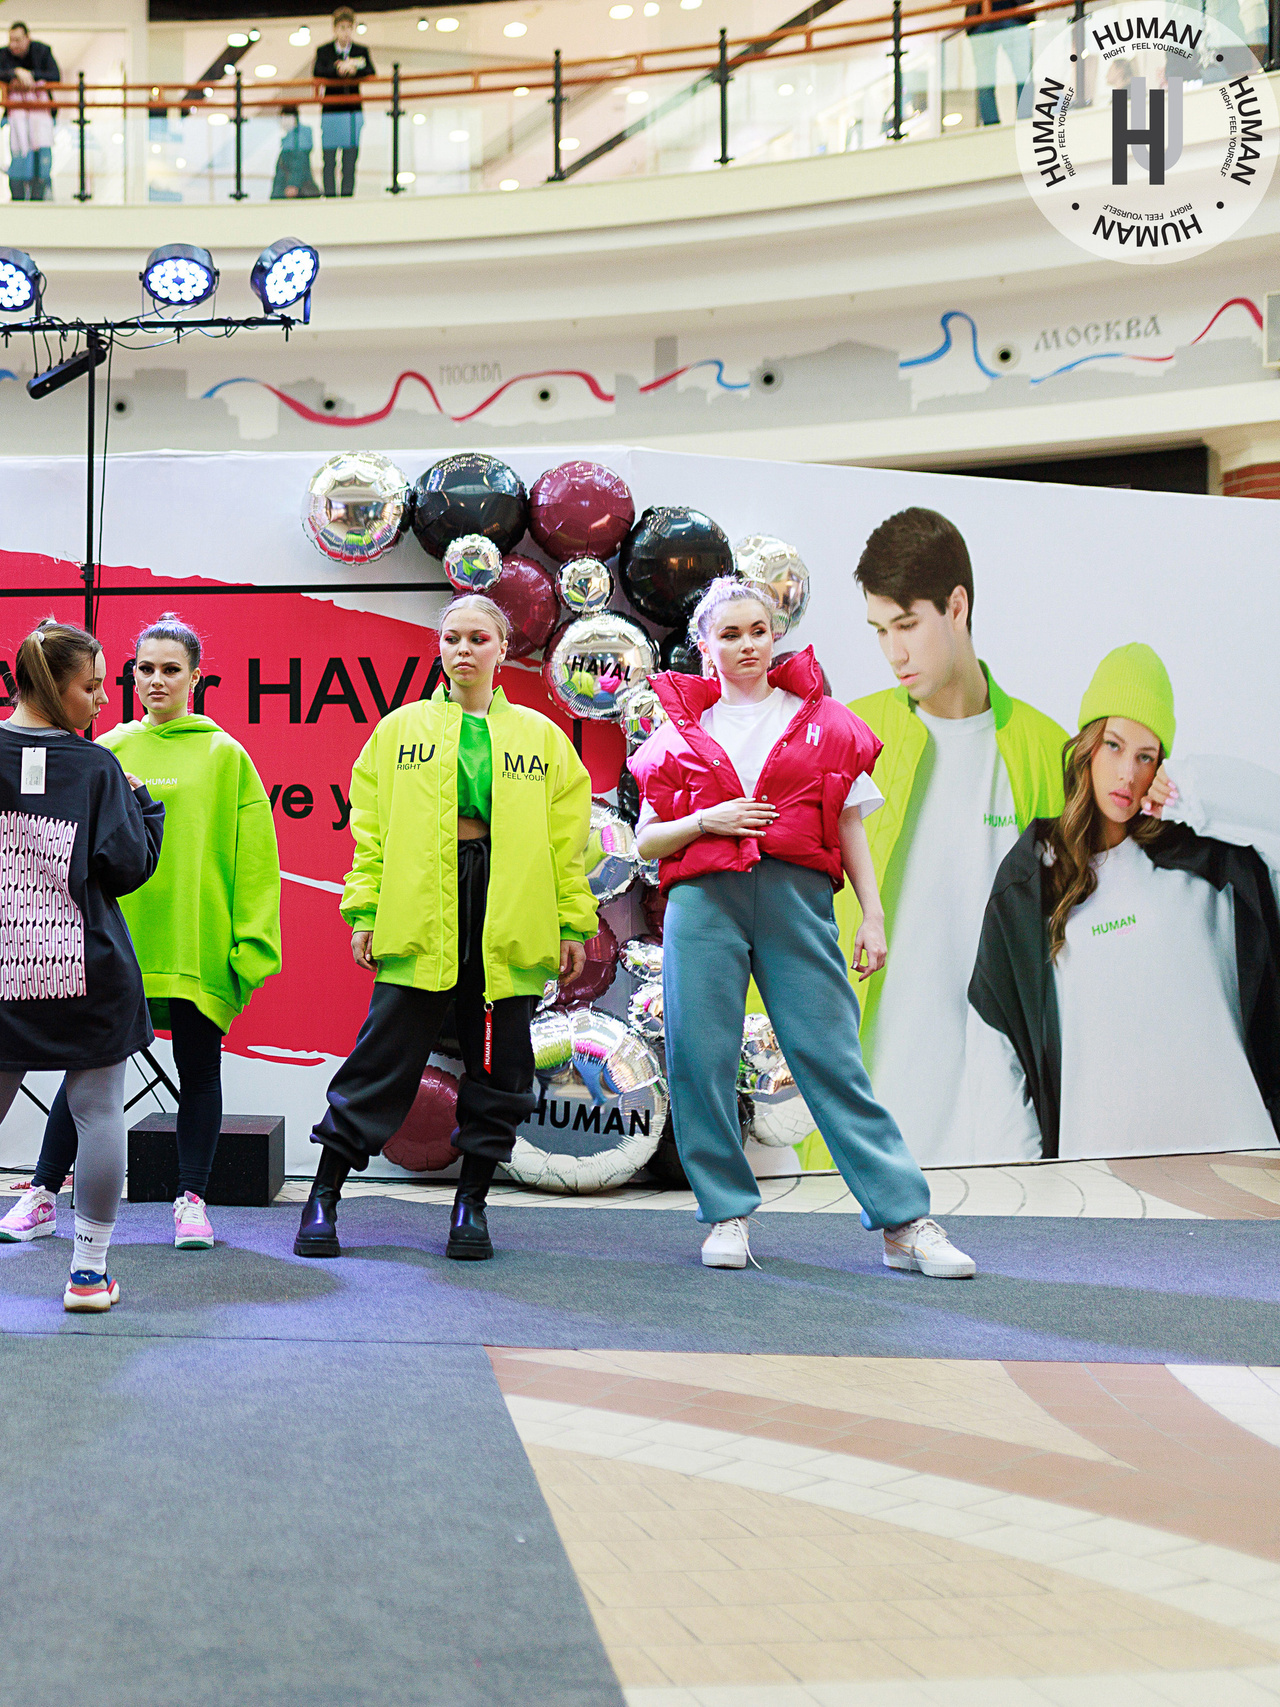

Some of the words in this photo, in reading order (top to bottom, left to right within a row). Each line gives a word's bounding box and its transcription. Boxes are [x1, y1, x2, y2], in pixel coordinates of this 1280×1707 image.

[1034, 315, 1161, 352] МОСКВА
[571, 655, 632, 682] HAVAL
[116, 658, 222, 724] fr
[248, 656, 452, 725] HAVA
[398, 743, 436, 763] HU
[502, 771, 522, 780] FEEL
[1091, 914, 1136, 936] HUMAN
[524, 1099, 650, 1136] HUMAN
[76, 1232, 93, 1243] AN
